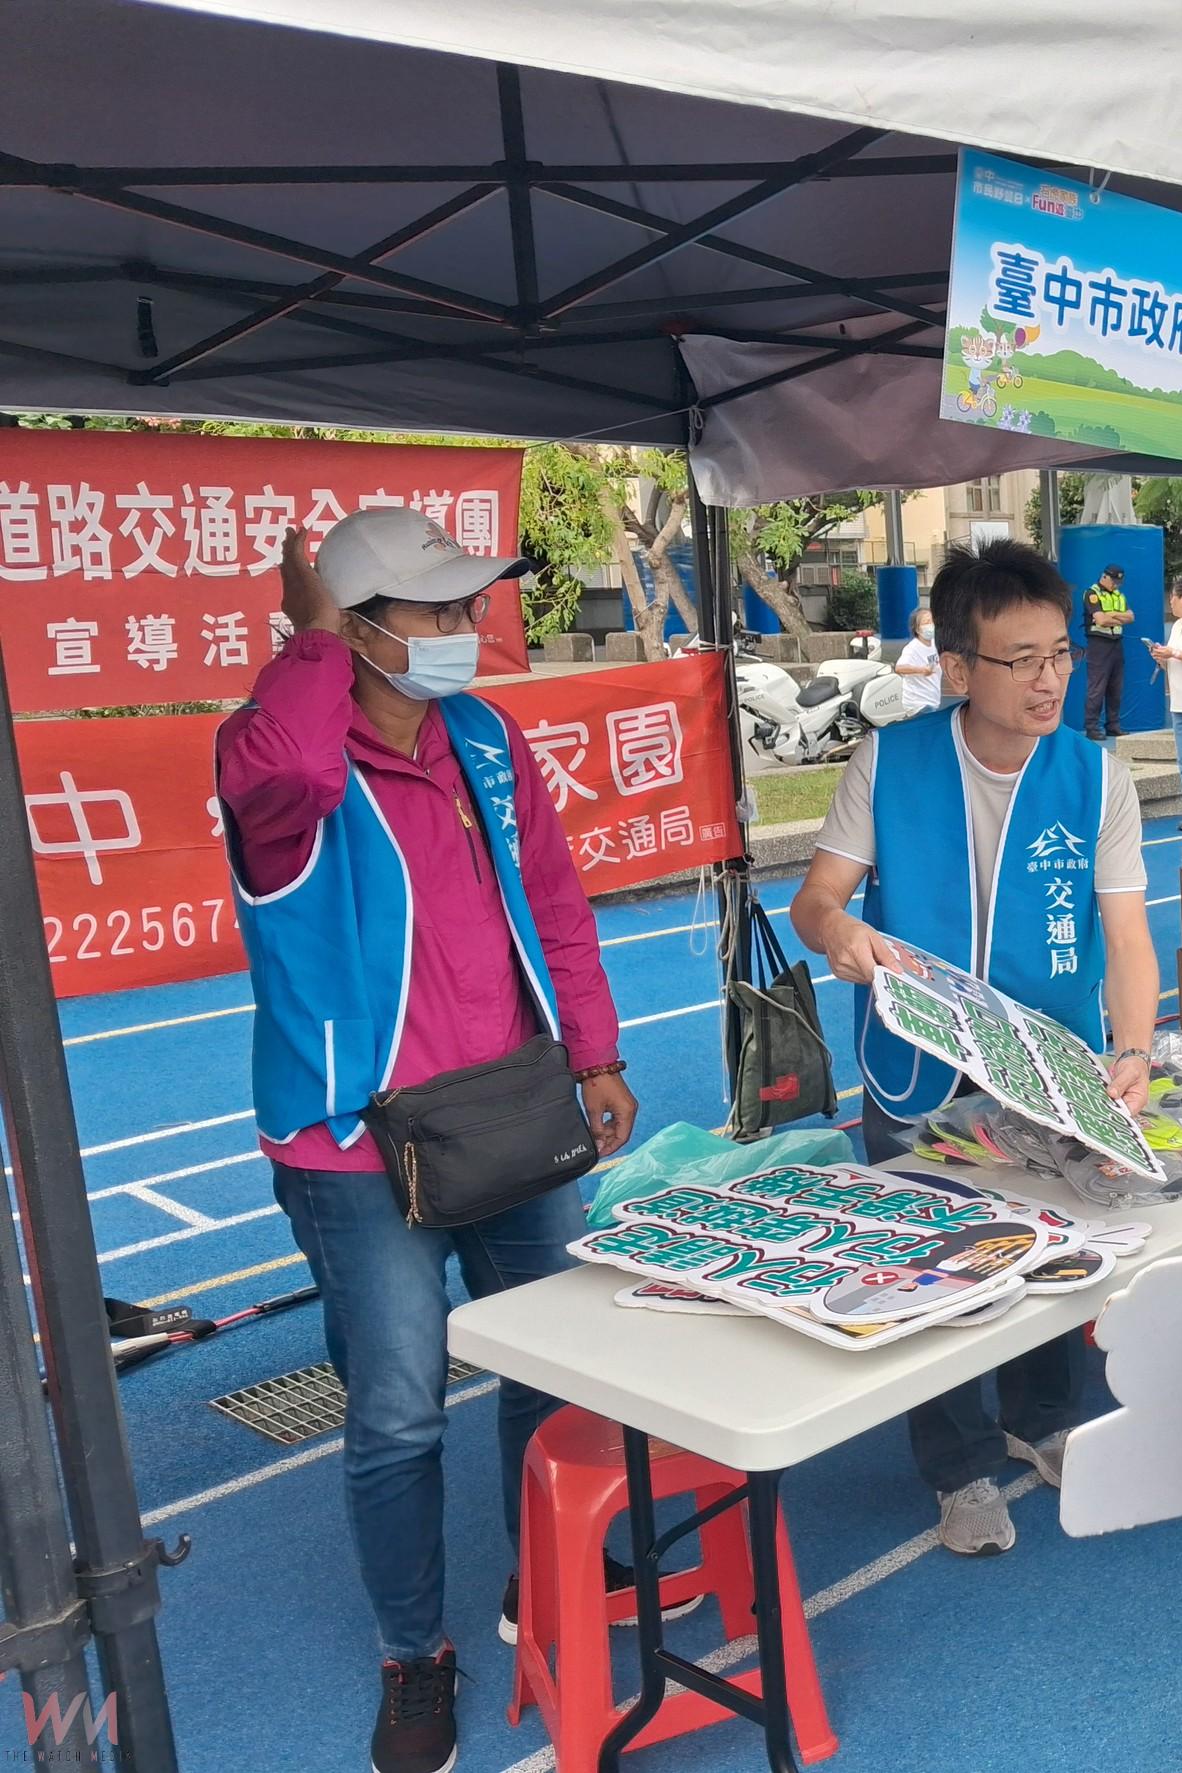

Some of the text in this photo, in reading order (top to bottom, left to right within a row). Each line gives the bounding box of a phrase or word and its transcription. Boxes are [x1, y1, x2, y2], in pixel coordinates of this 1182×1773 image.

[874, 694, 900, 710] POLICE
[521, 701, 685, 813] 家園
[566, 805, 695, 872] 交通局
[1026, 858, 1089, 873] 臺中市政府
[43, 899, 241, 964] 222567
[1043, 877, 1079, 980] 交通局
[628, 1190, 945, 1268] 行人穿越道
[734, 1169, 994, 1233] 不滑手機
[590, 1225, 850, 1298] 行人請走
